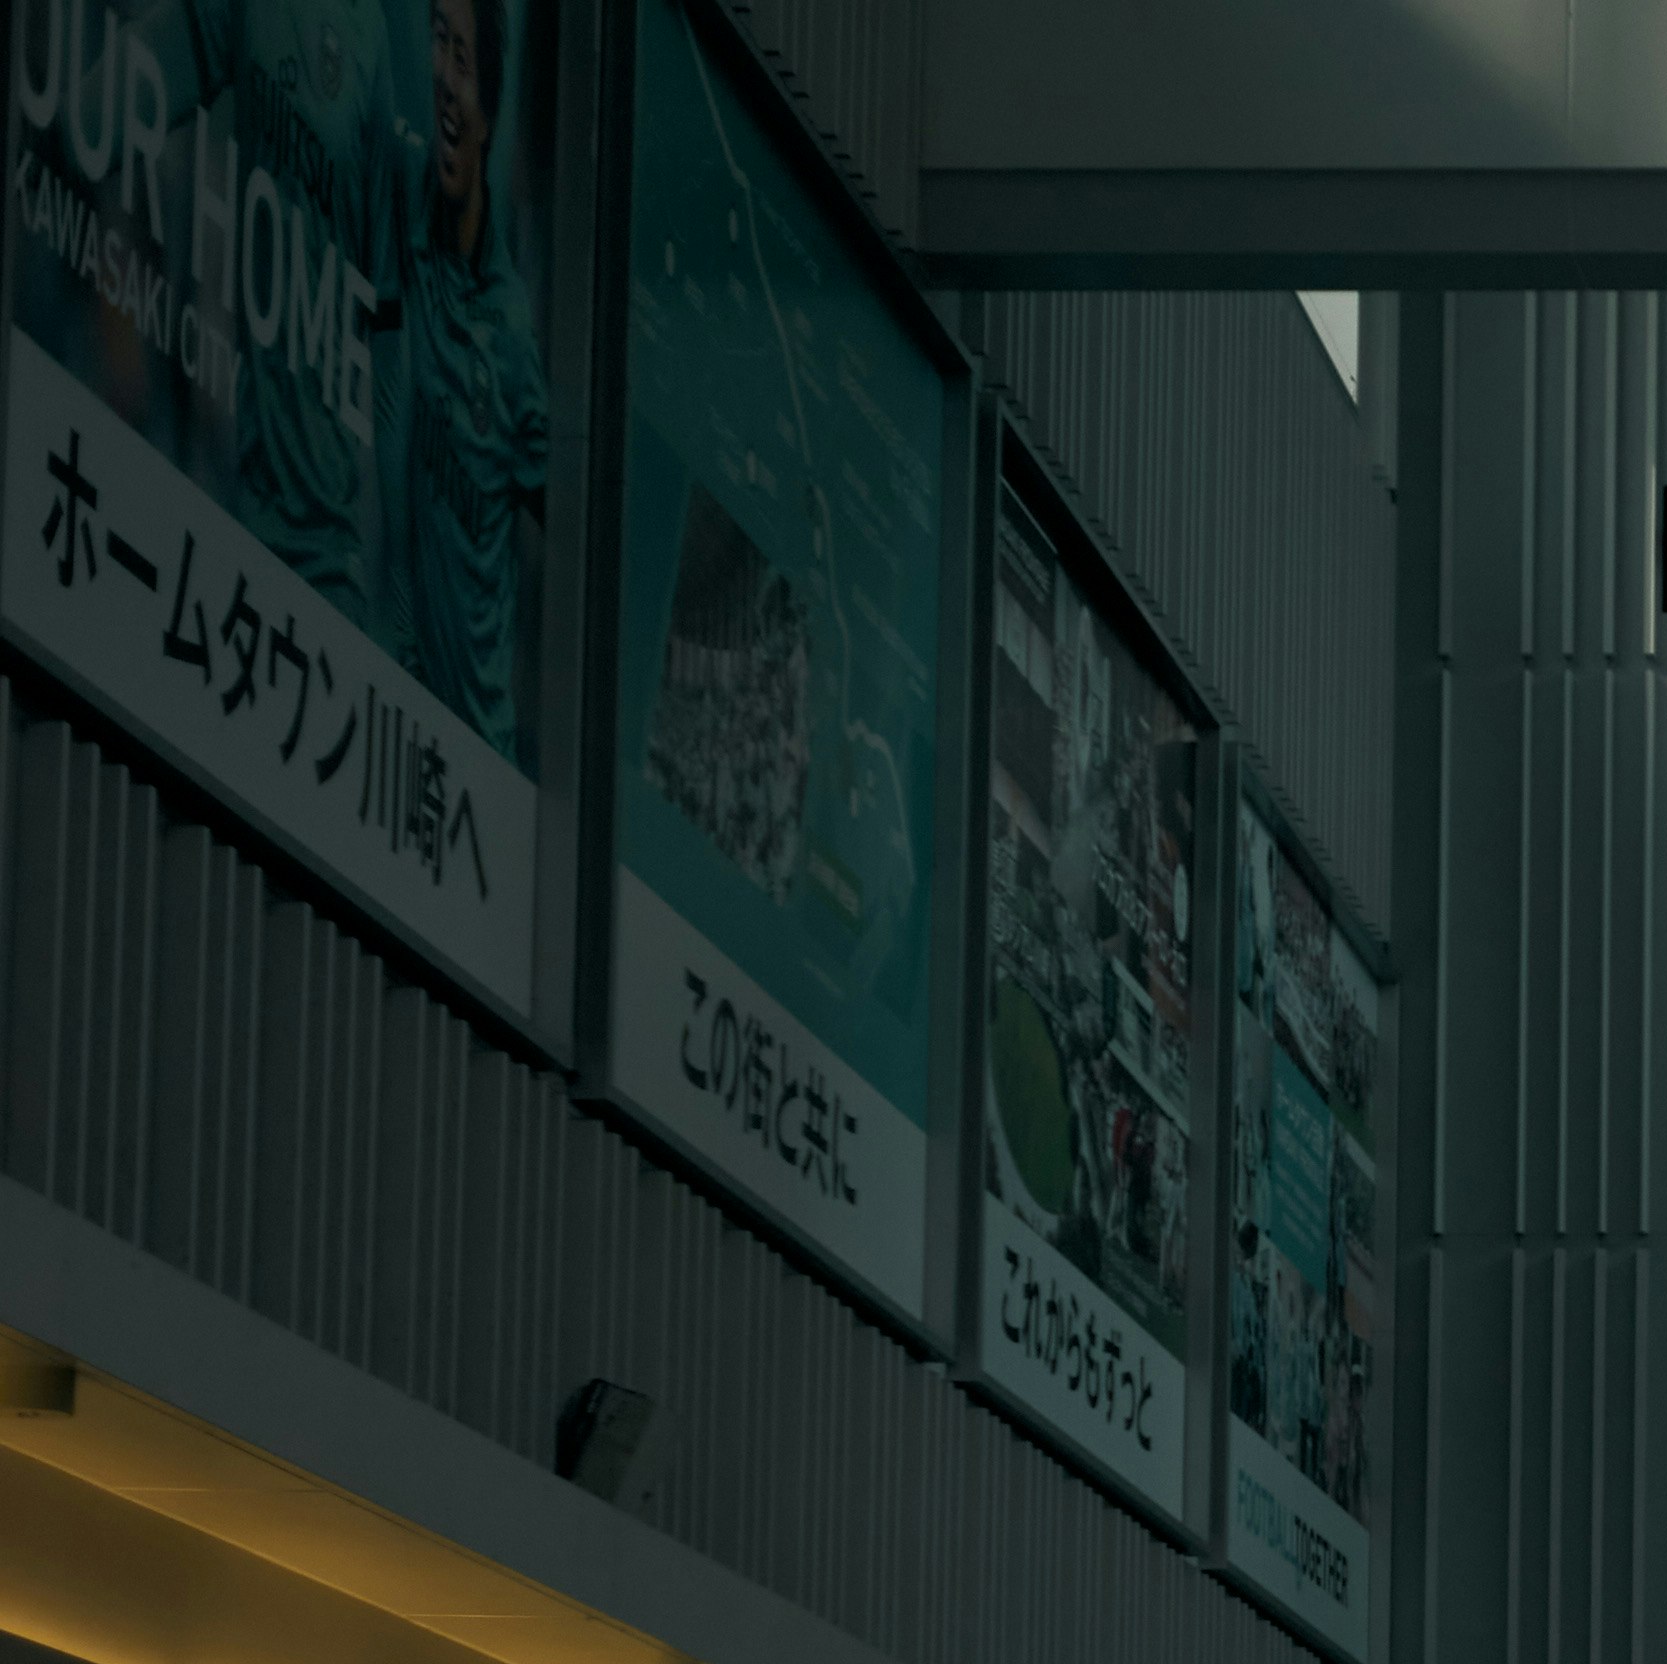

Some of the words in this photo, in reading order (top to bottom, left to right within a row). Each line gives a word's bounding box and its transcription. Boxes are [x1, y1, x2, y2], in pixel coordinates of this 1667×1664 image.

[16, 149, 174, 357] KAWASAKI
[181, 302, 242, 417] CITY
[193, 104, 378, 449] HOME
[43, 428, 488, 901] ホームタウン川崎へ
[681, 967, 858, 1205] この街と共に
[1002, 1246, 1153, 1451] これからもずっと
